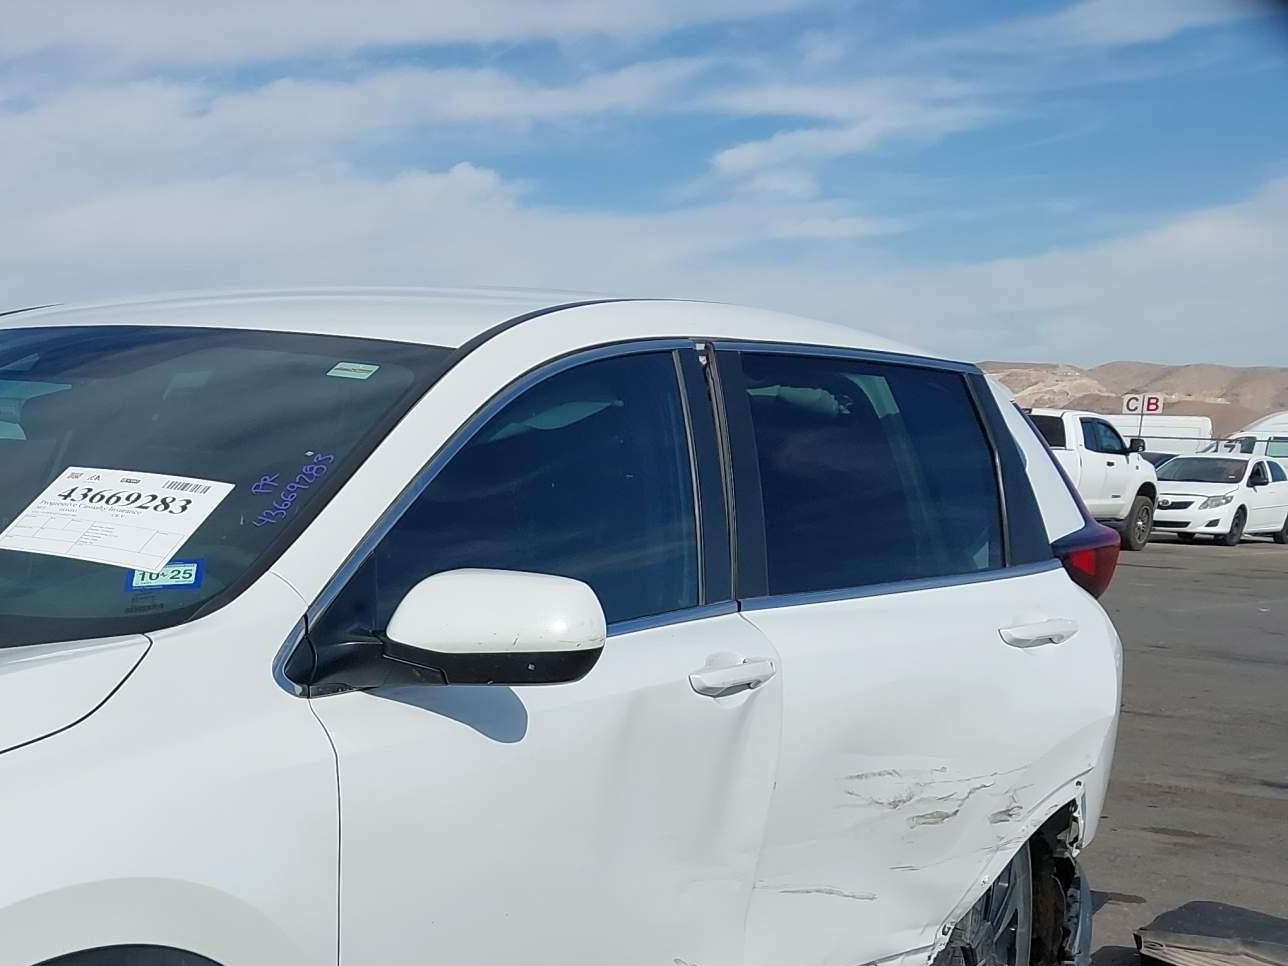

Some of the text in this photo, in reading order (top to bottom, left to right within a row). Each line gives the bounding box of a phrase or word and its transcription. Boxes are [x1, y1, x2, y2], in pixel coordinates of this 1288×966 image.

[1126, 396, 1139, 412] C
[1146, 396, 1160, 412] B
[57, 486, 193, 515] 43669283
[252, 453, 334, 527] 43669283
